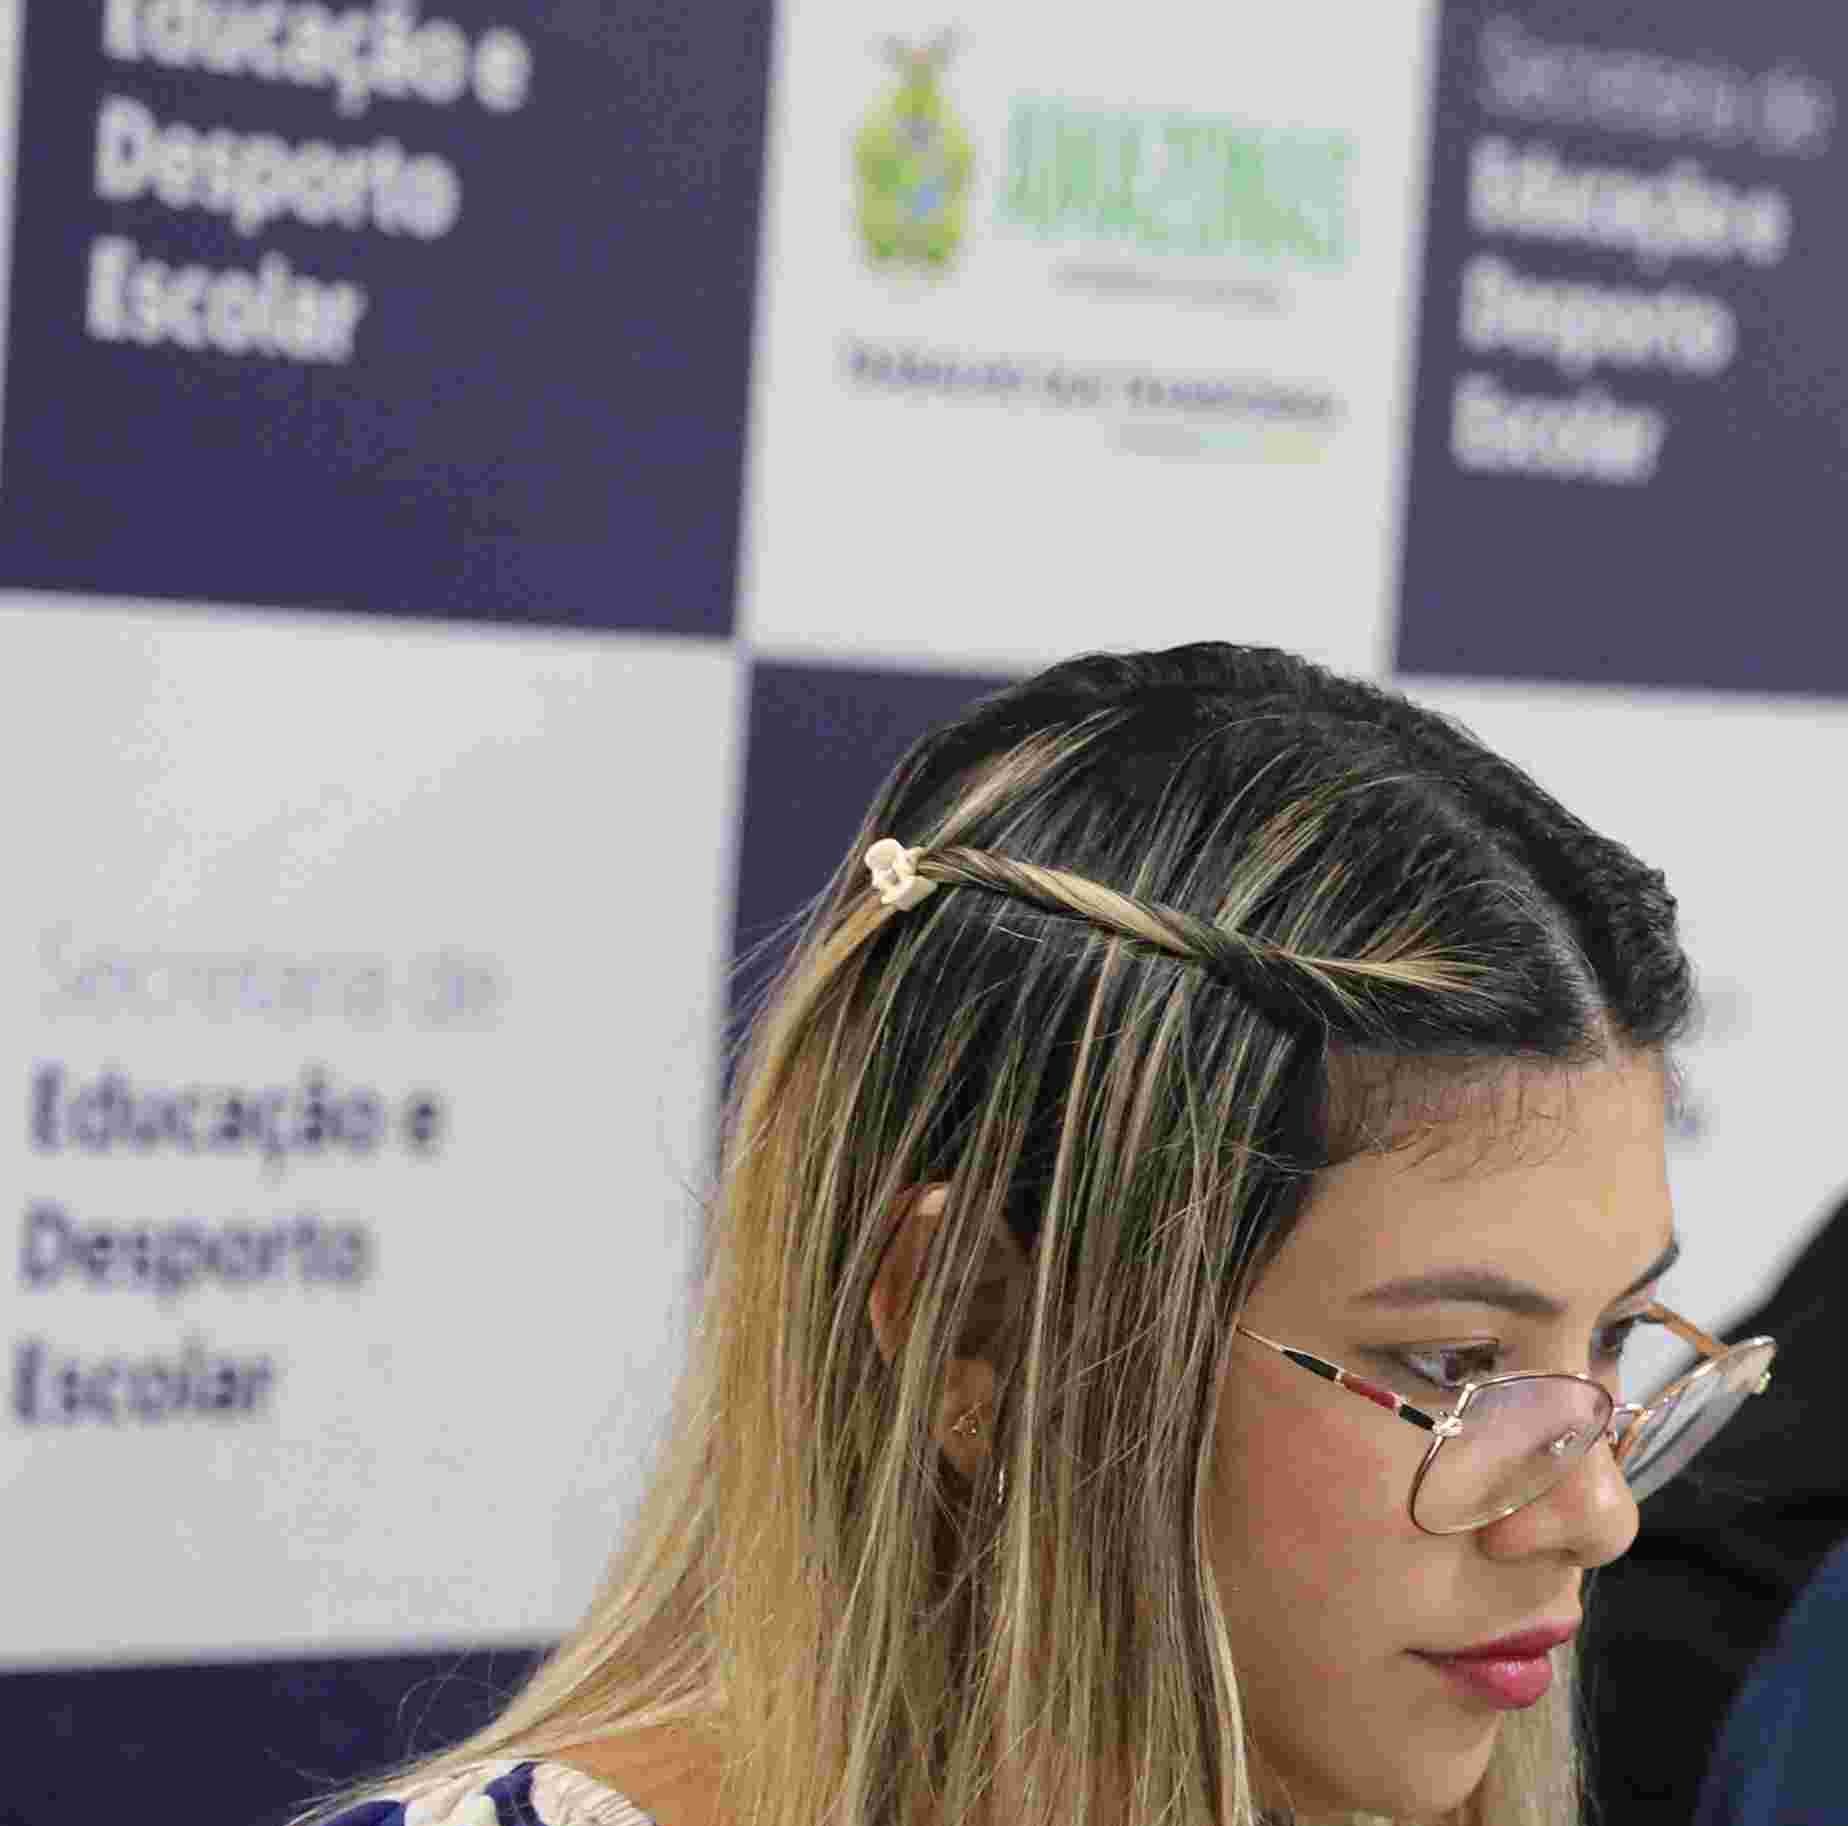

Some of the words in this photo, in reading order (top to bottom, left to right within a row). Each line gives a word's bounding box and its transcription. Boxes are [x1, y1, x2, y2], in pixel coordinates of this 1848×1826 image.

[102, 0, 469, 116] Educação
[472, 25, 531, 113] e
[96, 95, 461, 239] Desporto
[86, 234, 367, 364] Escolar
[30, 1056, 384, 1188] Educação
[401, 1084, 452, 1165] e
[20, 1195, 374, 1312] Desporto
[11, 1334, 276, 1430] Escolar
